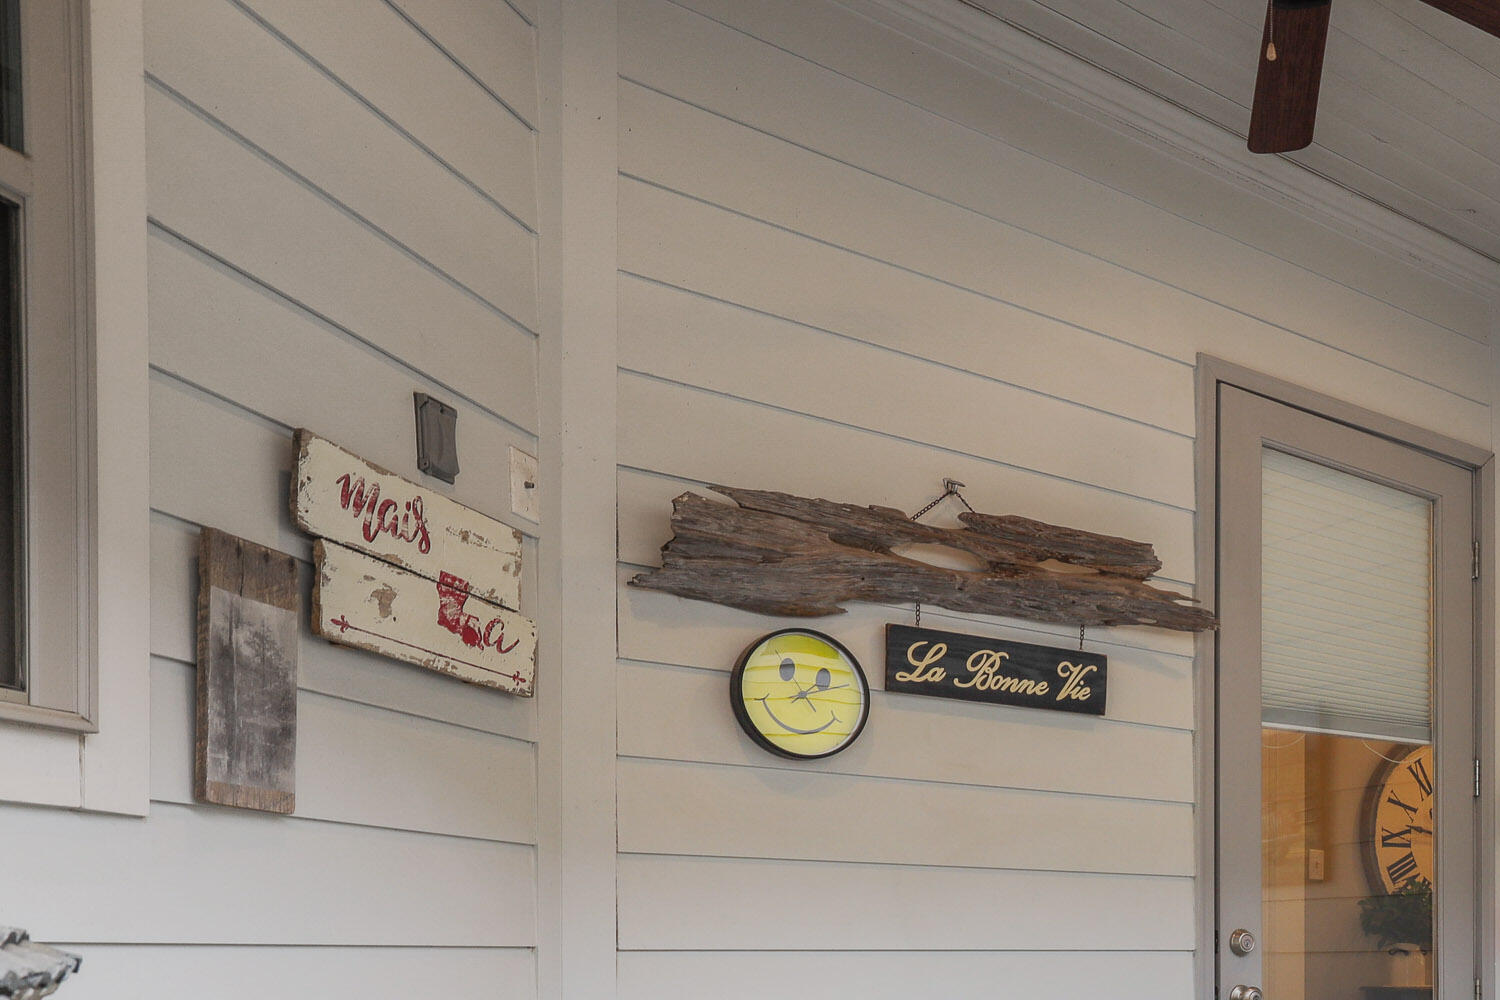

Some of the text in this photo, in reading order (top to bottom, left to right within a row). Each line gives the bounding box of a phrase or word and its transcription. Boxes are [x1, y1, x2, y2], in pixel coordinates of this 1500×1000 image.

[895, 641, 1098, 701] La Bonne Vie
